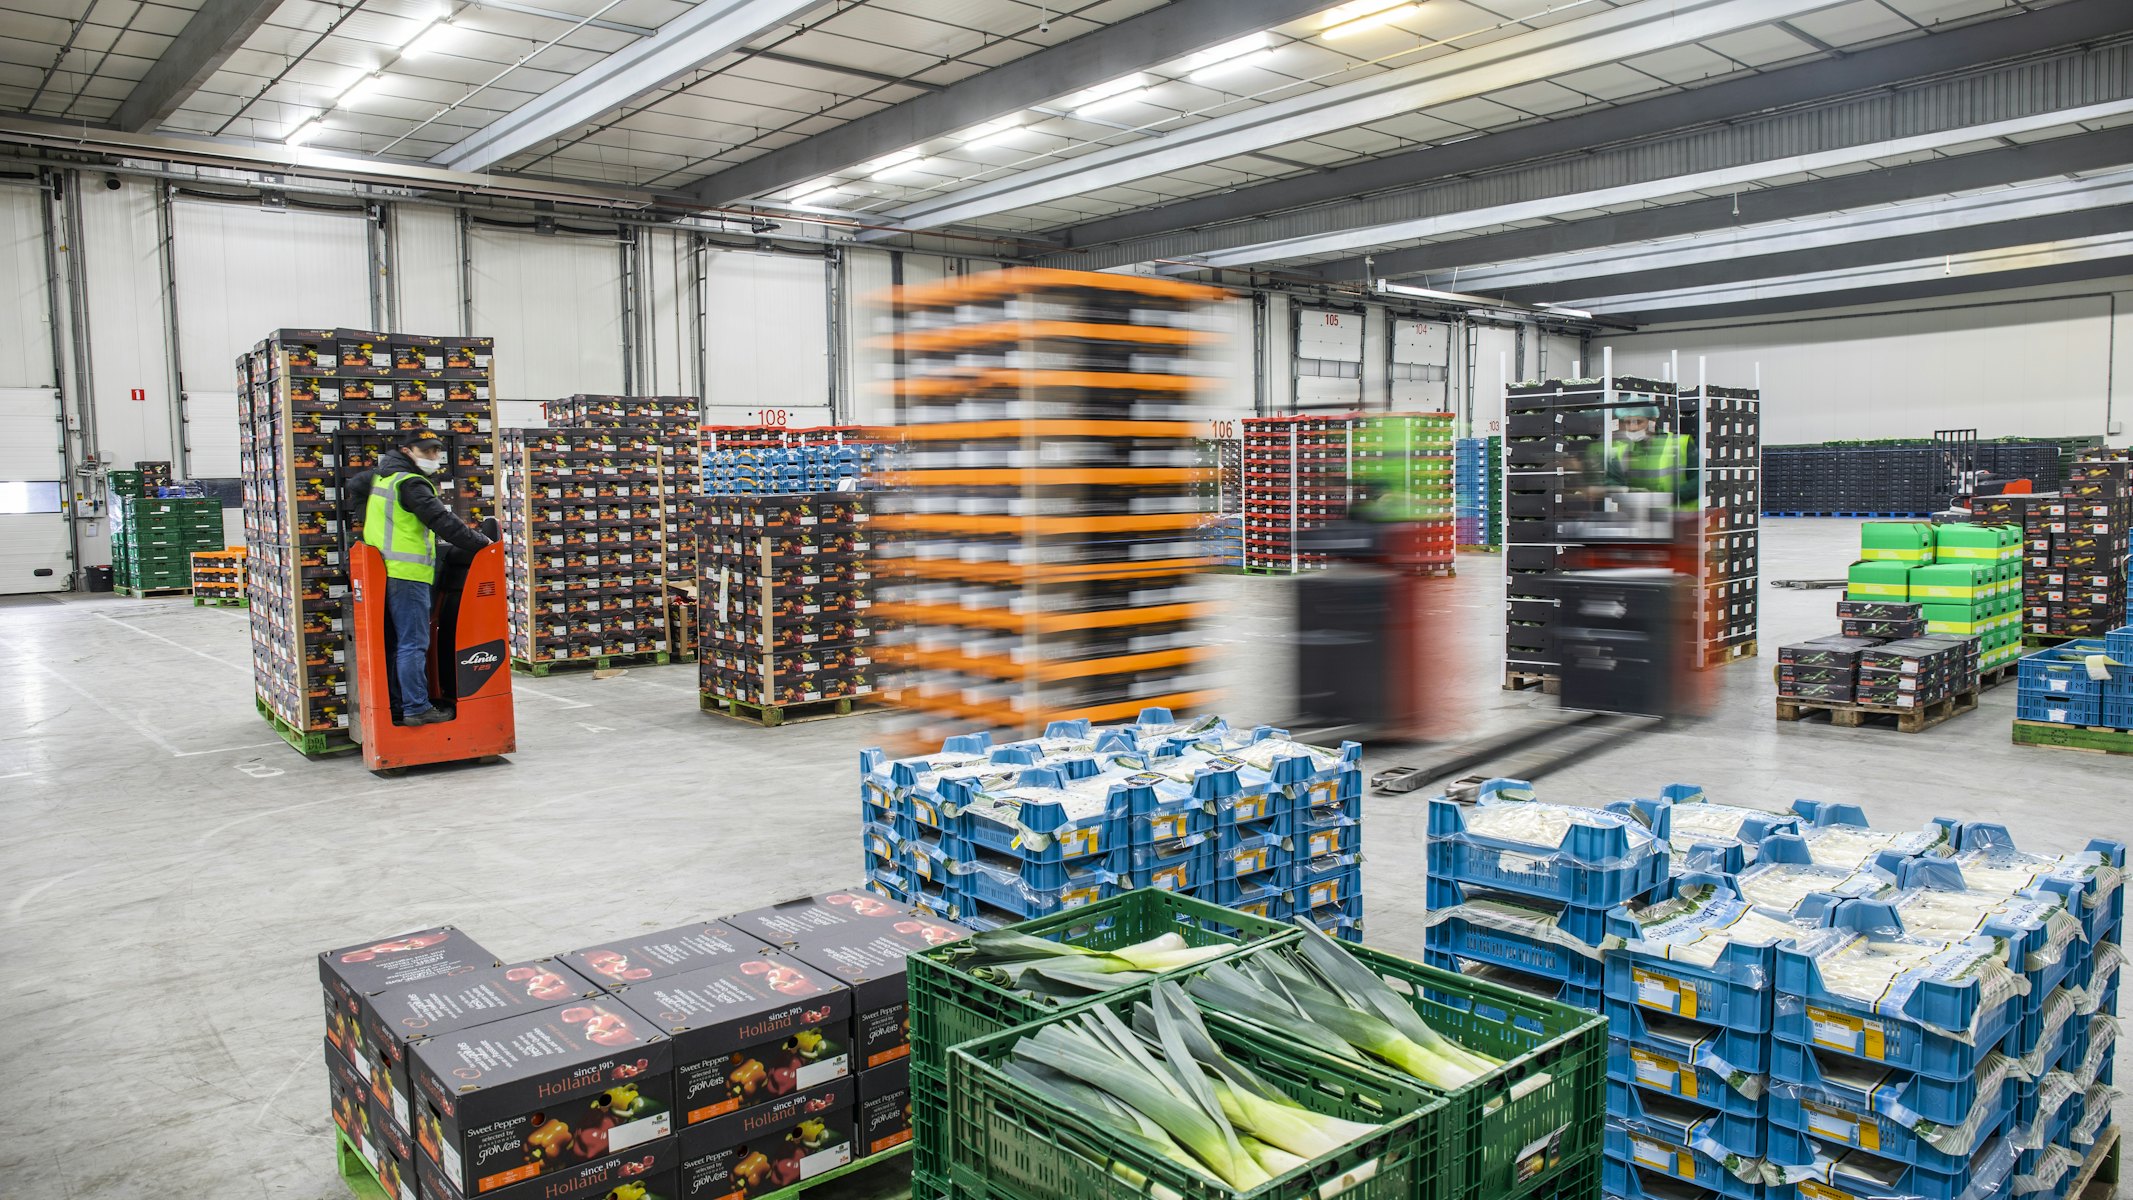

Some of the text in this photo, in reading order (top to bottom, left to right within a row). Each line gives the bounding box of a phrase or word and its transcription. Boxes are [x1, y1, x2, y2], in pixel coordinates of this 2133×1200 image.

[1325, 314, 1338, 326] 105
[1416, 324, 1428, 336] 104
[758, 410, 786, 426] 108
[1489, 420, 1500, 432] 103
[1212, 420, 1232, 438] 106
[461, 652, 498, 664] Linde
[768, 1006, 802, 1022] since 1915
[862, 1004, 902, 1022] Sweet Peppers
[738, 1016, 792, 1040] Holland
[868, 1024, 898, 1045] growers
[574, 1060, 614, 1078] since 1915
[680, 1055, 729, 1074] Sweet Peppers
[538, 1070, 600, 1098] Holland
[687, 1076, 724, 1100] growers
[772, 1095, 806, 1112] since 1915
[864, 1090, 904, 1109] Sweet Peppers
[467, 1116, 526, 1138] Sweet Peppers
[744, 1106, 796, 1132] Holland
[870, 1110, 900, 1132] growers
[481, 1130, 514, 1143] selected by
[476, 1140, 520, 1166] growers
[684, 1150, 732, 1170] Sweet Peppers
[580, 1158, 620, 1178] since 1915
[546, 1169, 608, 1198] Holland
[691, 1170, 728, 1194] growers
